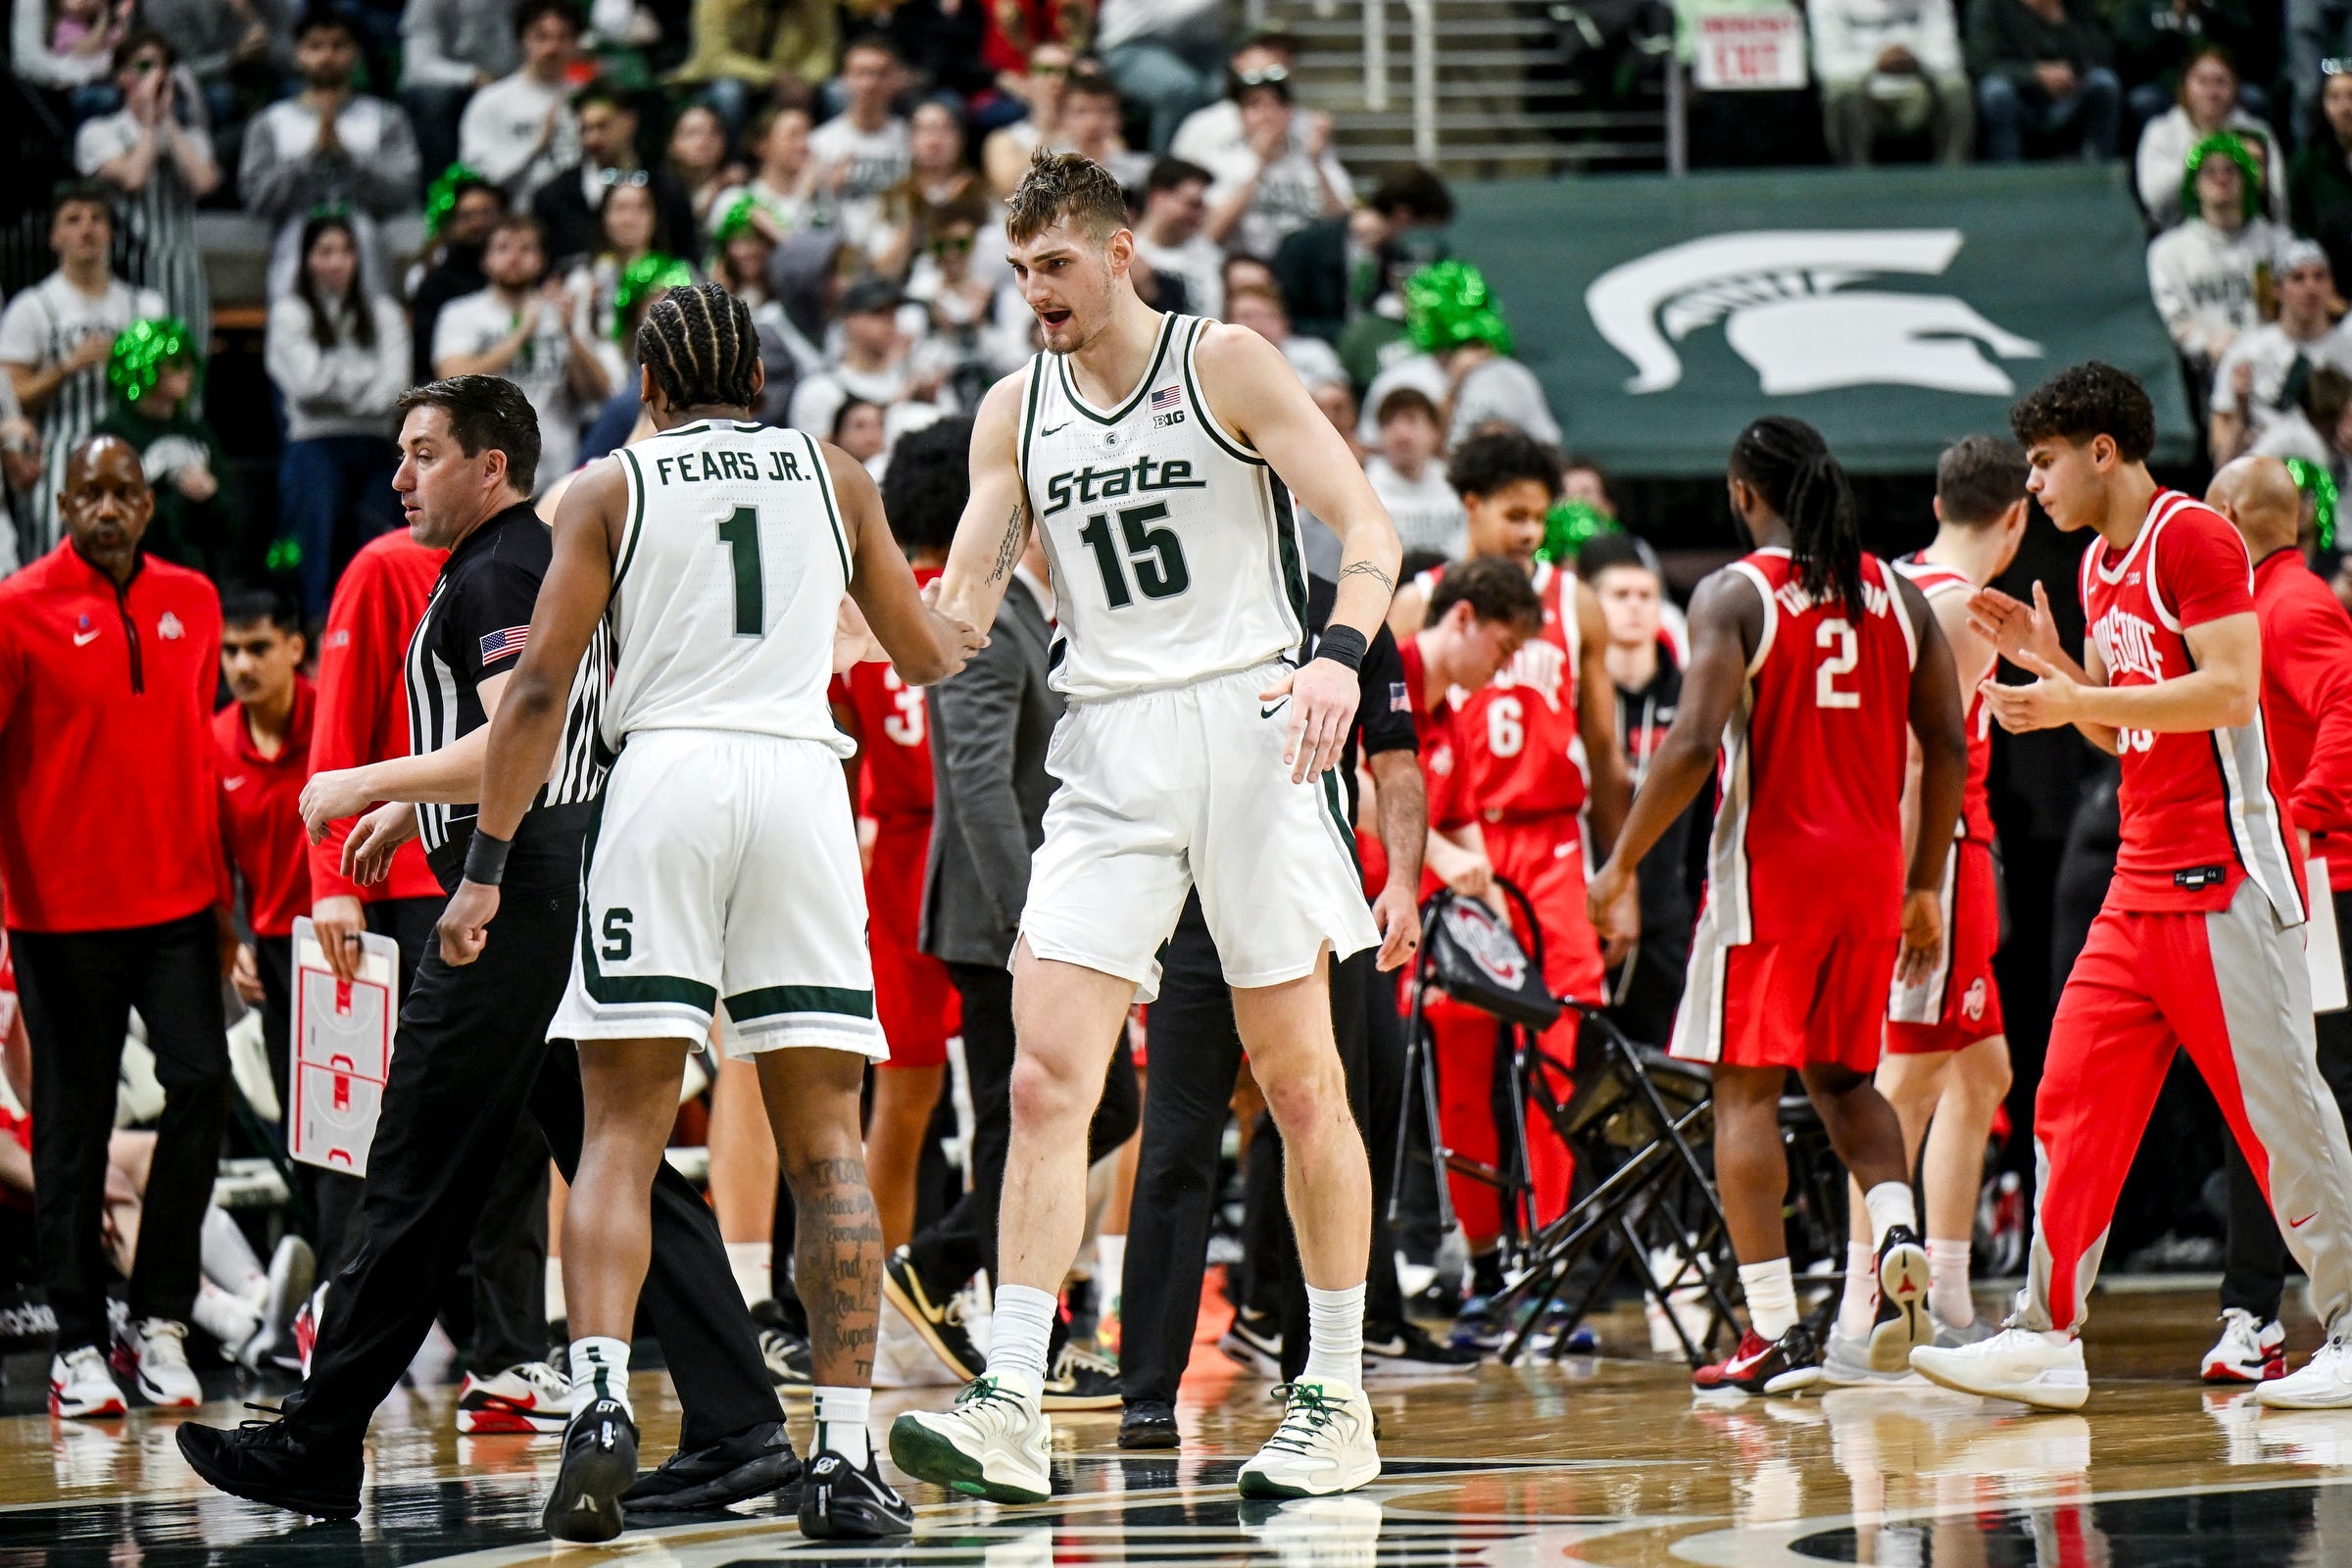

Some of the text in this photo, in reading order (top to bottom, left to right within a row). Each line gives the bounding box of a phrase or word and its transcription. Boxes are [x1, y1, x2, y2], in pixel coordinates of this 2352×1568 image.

[657, 451, 811, 485] FEARS JR.
[1043, 455, 1208, 519] State
[715, 503, 766, 638] 1
[1078, 498, 1192, 612] 15
[1816, 617, 1861, 710] 2
[884, 664, 926, 747] 3
[1487, 696, 1525, 759] 6
[602, 907, 633, 960] S
[596, 1399, 621, 1413] GT
